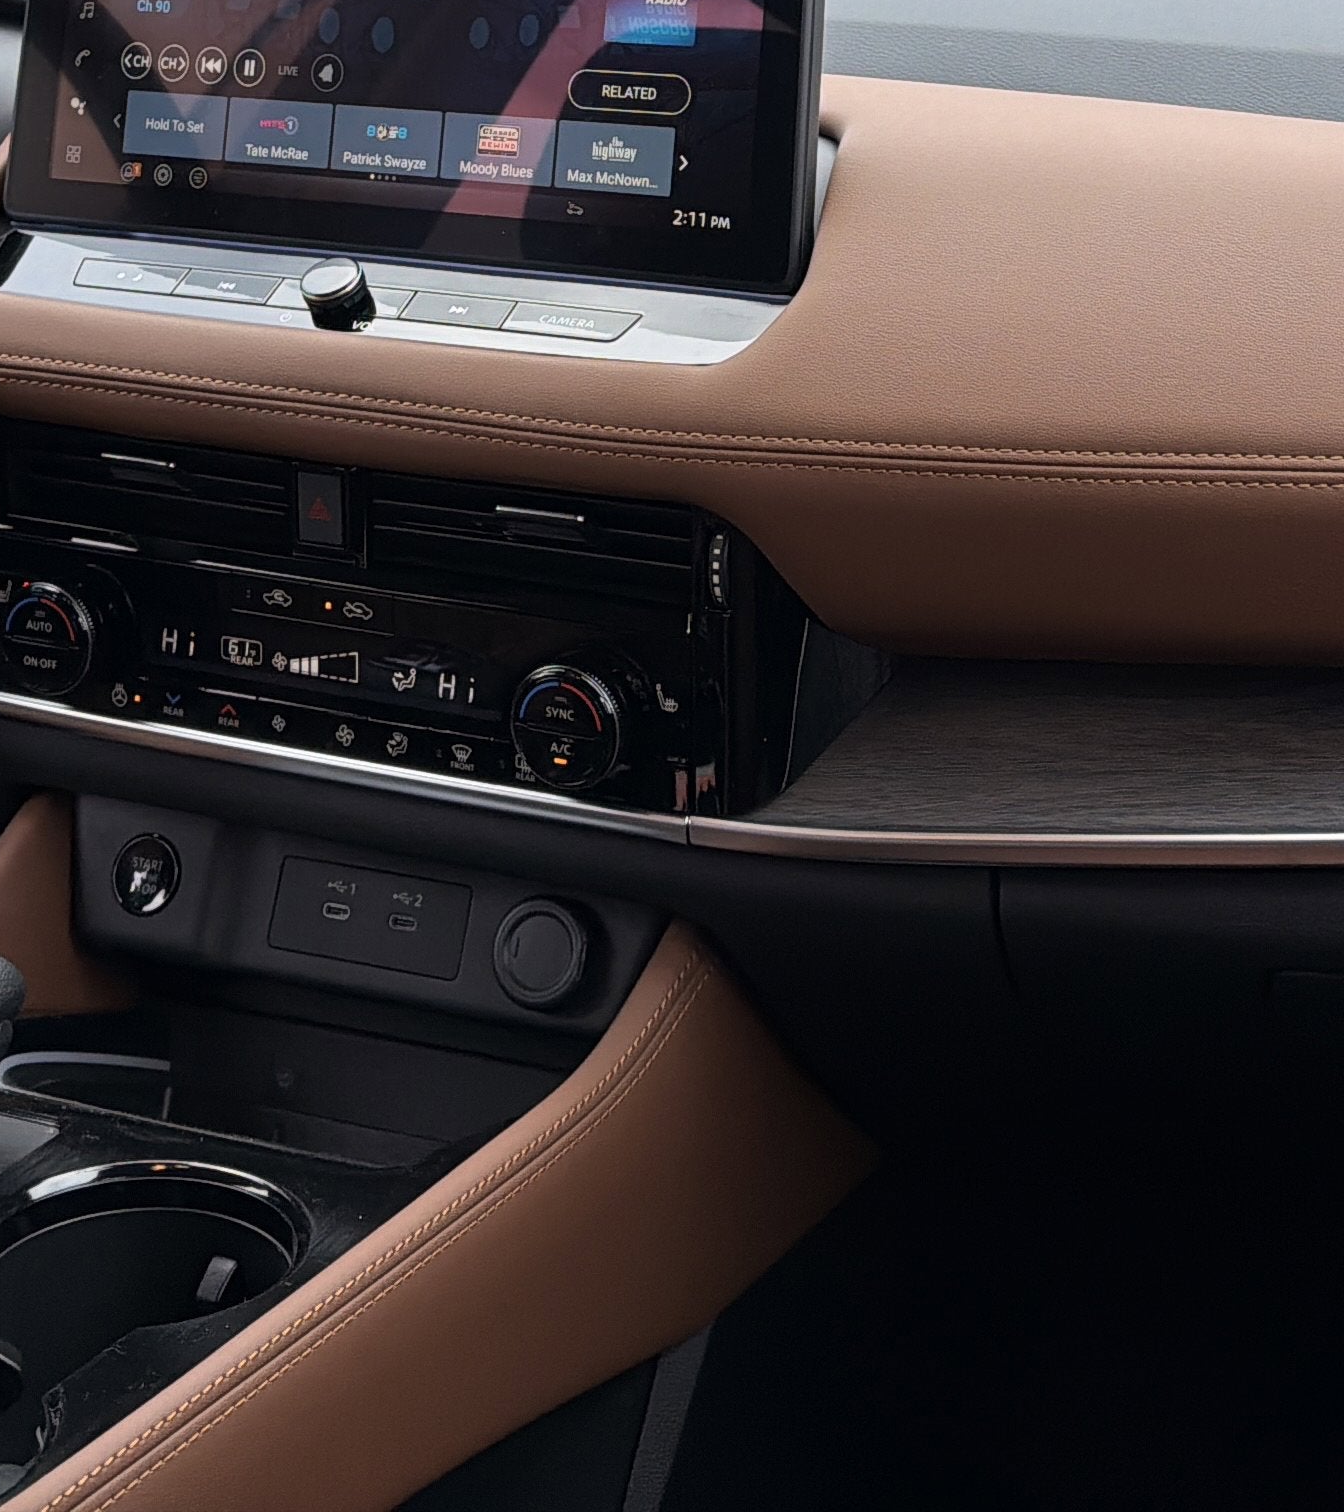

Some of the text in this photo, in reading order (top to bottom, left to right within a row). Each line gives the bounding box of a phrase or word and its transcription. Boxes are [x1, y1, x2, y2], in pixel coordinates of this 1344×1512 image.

[155, 0, 171, 14] 90
[278, 65, 299, 77] LIVE
[601, 85, 657, 101] RELATED
[145, 118, 205, 135] Hold To Set
[481, 141, 516, 149] REWIND
[592, 140, 637, 163] highway
[245, 144, 309, 162] Tate McRae
[343, 151, 427, 171] Patrick Swayze
[459, 159, 534, 179] Moody Blues
[567, 169, 594, 185] Max
[673, 210, 731, 230] 2:11 PM
[352, 320, 377, 332] VO
[539, 314, 596, 329] CAMERA
[26, 619, 53, 633] AUTO
[161, 628, 195, 657] Hi
[230, 655, 254, 667] REAR
[438, 672, 476, 704] Hi
[163, 705, 184, 718] REAR
[545, 706, 575, 722] SYNC
[218, 716, 240, 728] REAR
[549, 741, 572, 755] A/C
[449, 760, 475, 771] FRONT
[515, 771, 536, 783] REAR
[132, 856, 163, 872] START
[414, 894, 424, 908] 2
